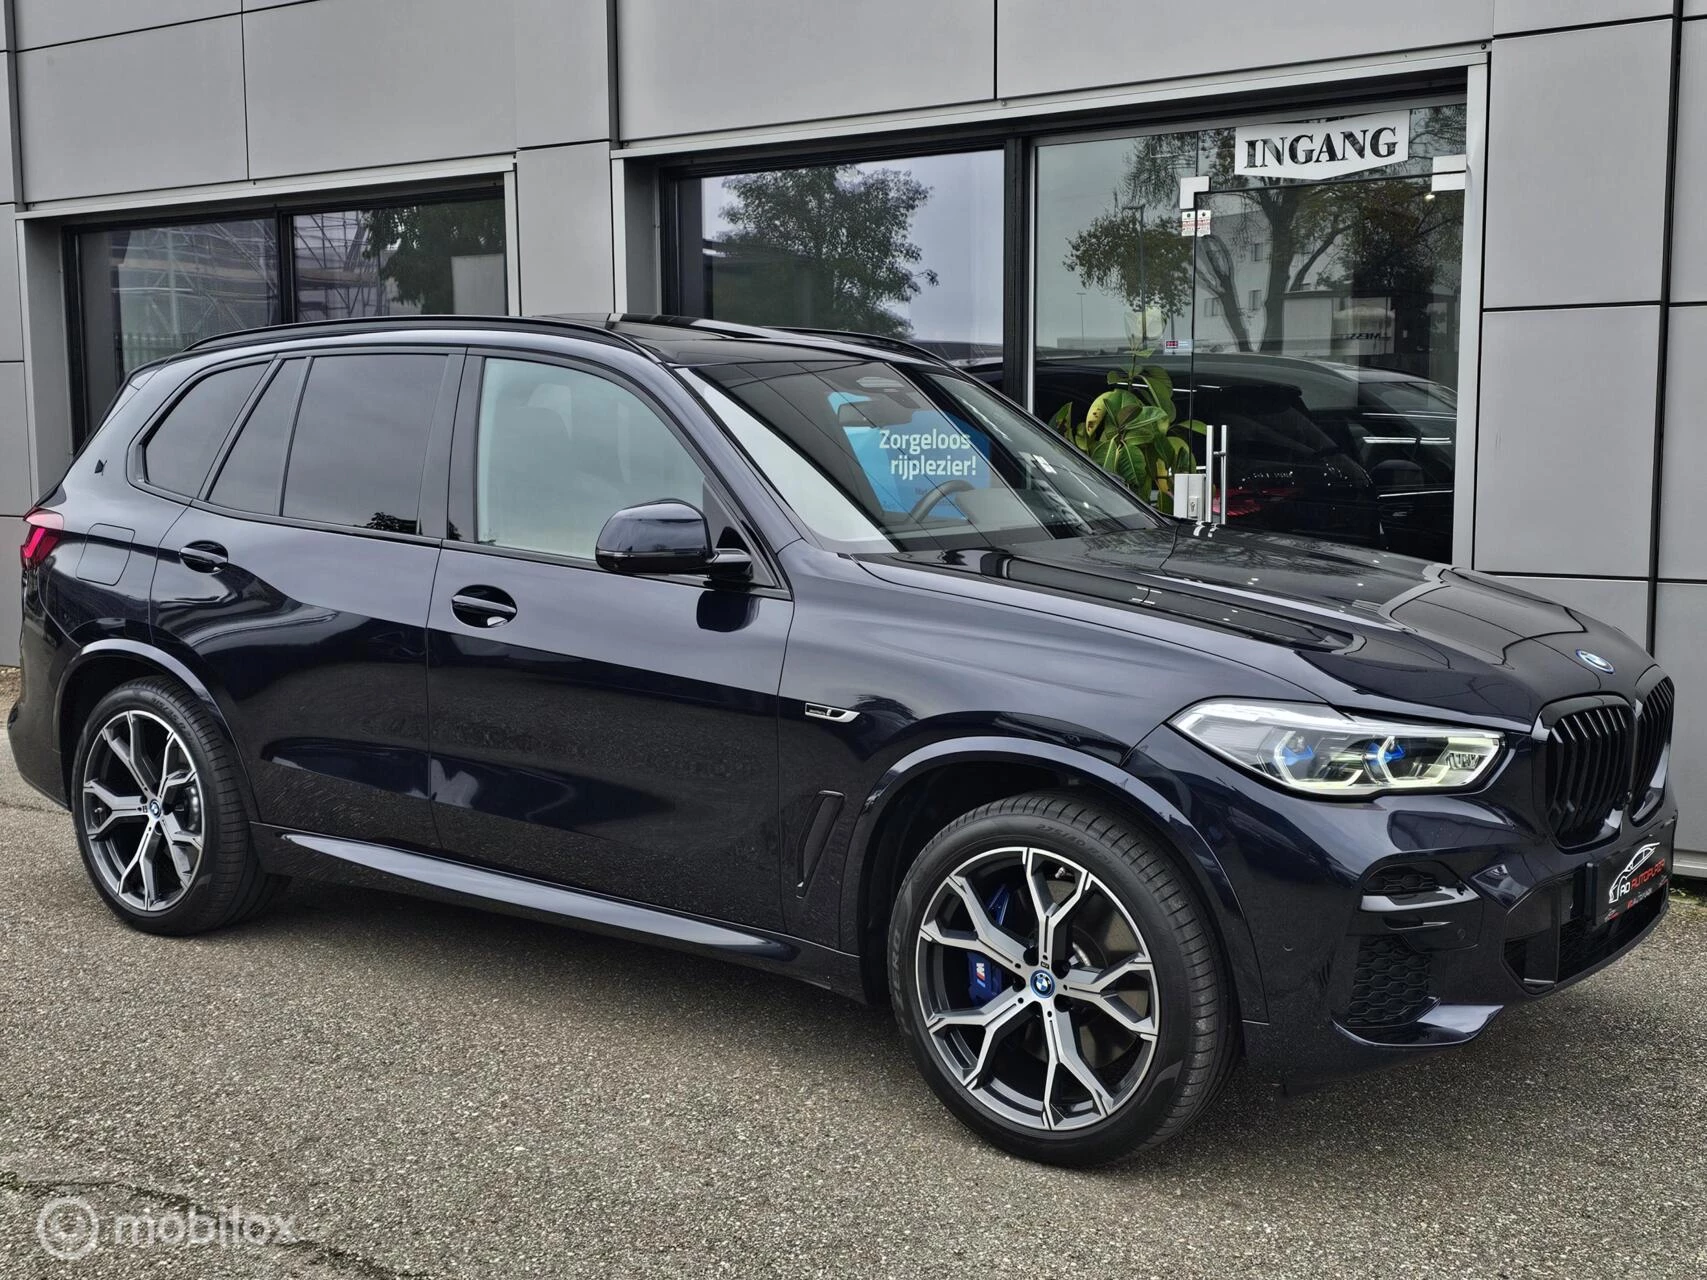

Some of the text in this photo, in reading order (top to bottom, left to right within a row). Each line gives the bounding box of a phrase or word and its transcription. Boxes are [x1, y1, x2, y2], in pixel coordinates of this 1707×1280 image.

[1244, 126, 1399, 169] INGANG
[879, 428, 971, 455] Zorgeloos
[890, 454, 977, 480] rijplezier!
